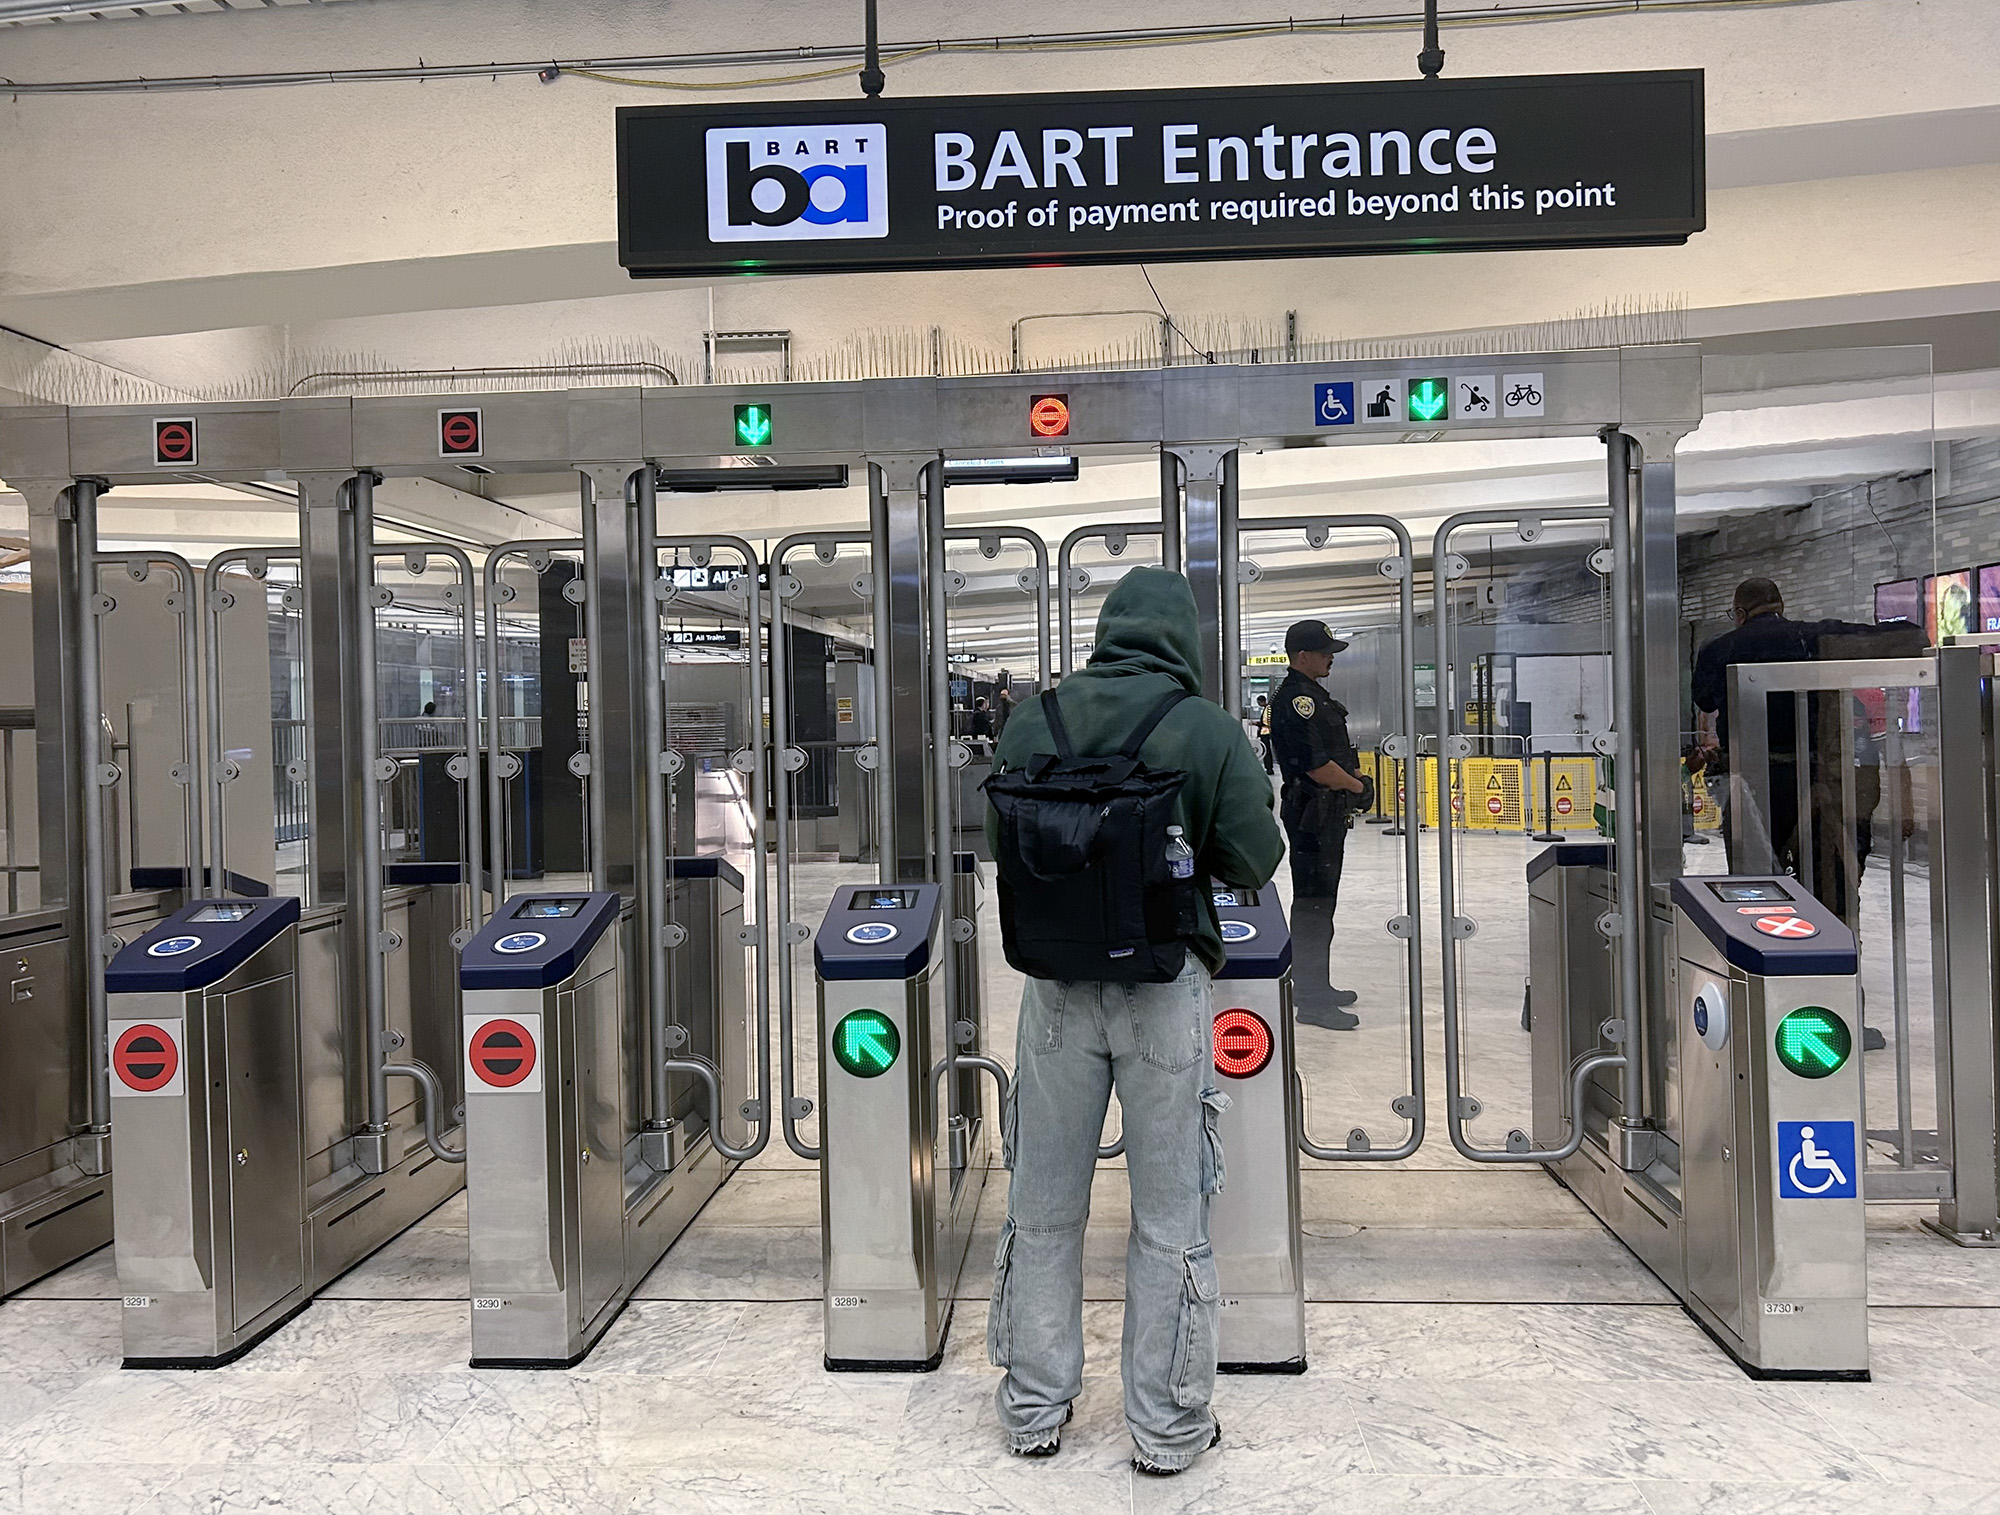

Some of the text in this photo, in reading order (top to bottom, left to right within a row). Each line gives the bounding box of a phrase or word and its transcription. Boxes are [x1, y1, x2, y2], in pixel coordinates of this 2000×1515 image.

[766, 138, 868, 156] BART
[935, 124, 1497, 191] BART Entrance
[937, 181, 1616, 232] Proof of payment required beyond this point
[695, 634, 726, 642] All Trains
[125, 1297, 146, 1306] 3291
[476, 1299, 500, 1309] 3290
[834, 1297, 858, 1307] 3289
[1766, 1303, 1792, 1313] 3730
